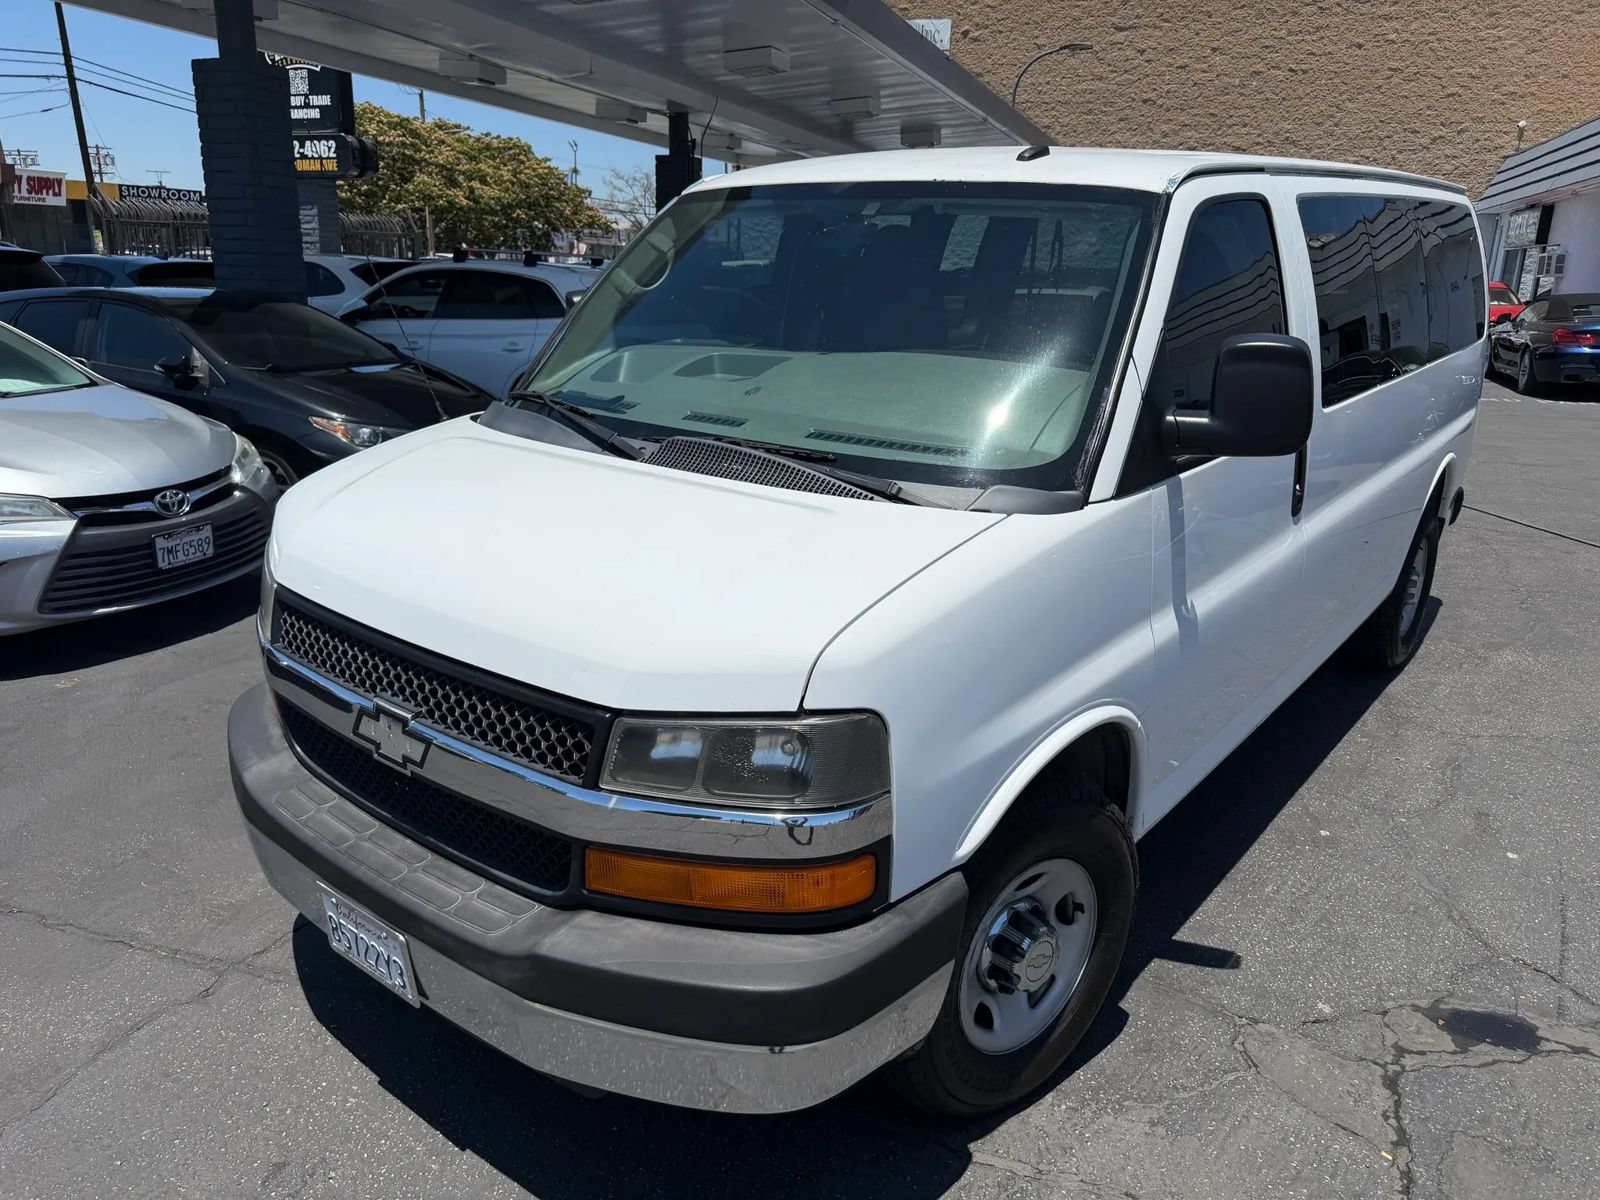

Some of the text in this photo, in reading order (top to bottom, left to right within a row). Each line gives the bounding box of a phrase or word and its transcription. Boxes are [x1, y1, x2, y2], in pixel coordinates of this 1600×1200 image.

[290, 95, 332, 107] BUY TRADE
[294, 159, 321, 171] DMAN
[26, 175, 63, 197] SUPPLY
[121, 185, 201, 202] SHOWROOM
[158, 535, 212, 564] 7MFG589
